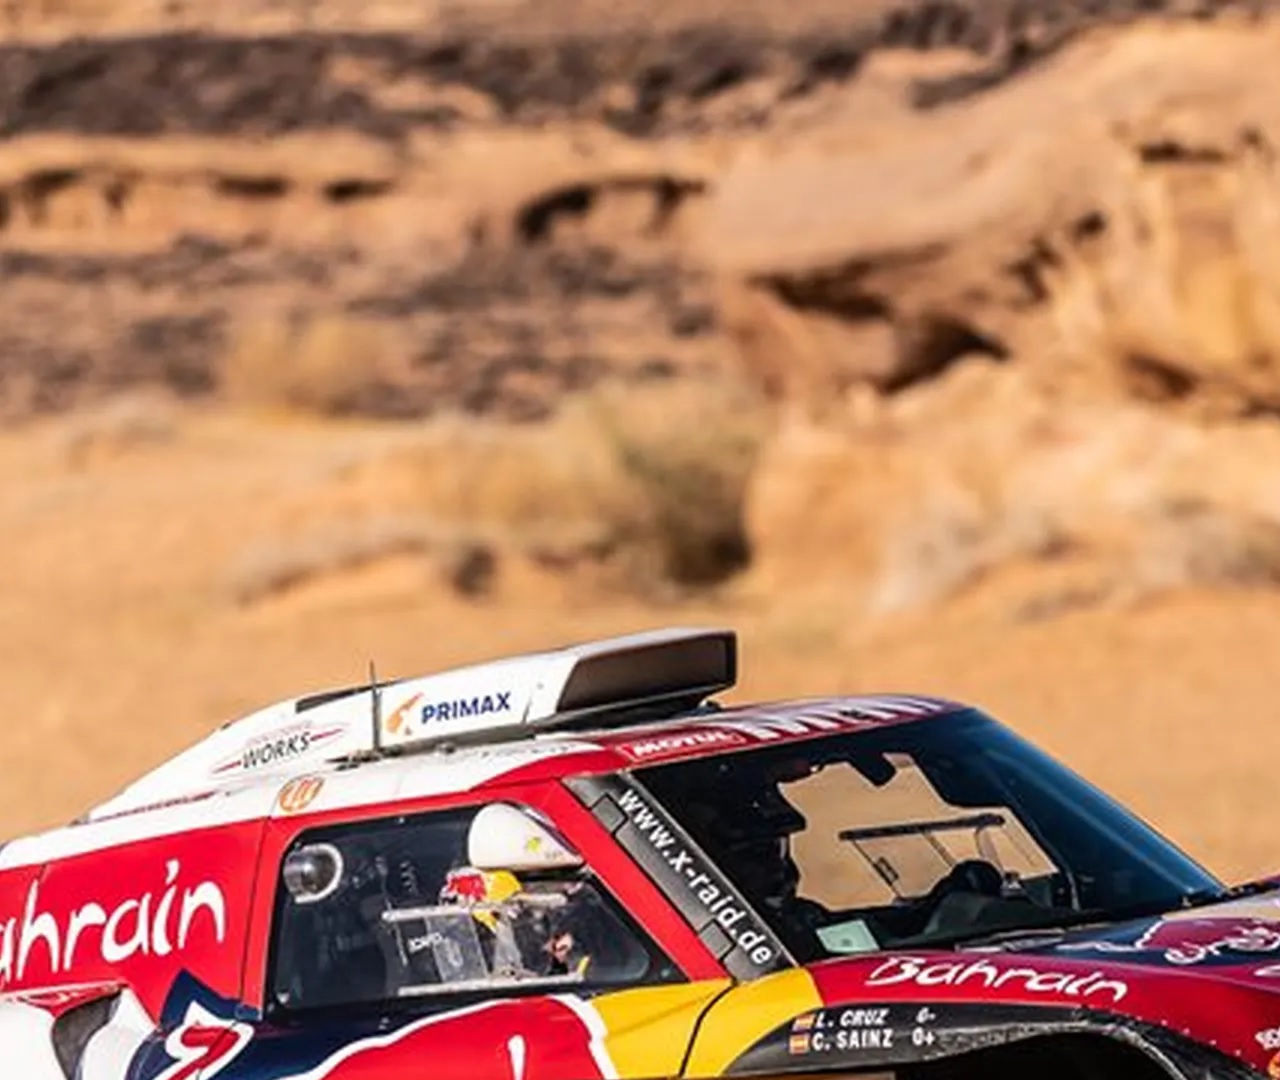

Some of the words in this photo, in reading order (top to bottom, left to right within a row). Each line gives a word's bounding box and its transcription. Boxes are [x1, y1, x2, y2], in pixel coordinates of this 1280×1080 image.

[422, 692, 511, 724] PRIMAX
[242, 731, 311, 769] WORKS
[619, 789, 772, 964] www.x-raid.de
[864, 955, 1128, 1001] Bahrain
[814, 1012, 834, 1028] L.
[839, 1009, 889, 1026] CRUZ
[812, 1032, 831, 1051] C.
[836, 1028, 893, 1049] SAINZ
